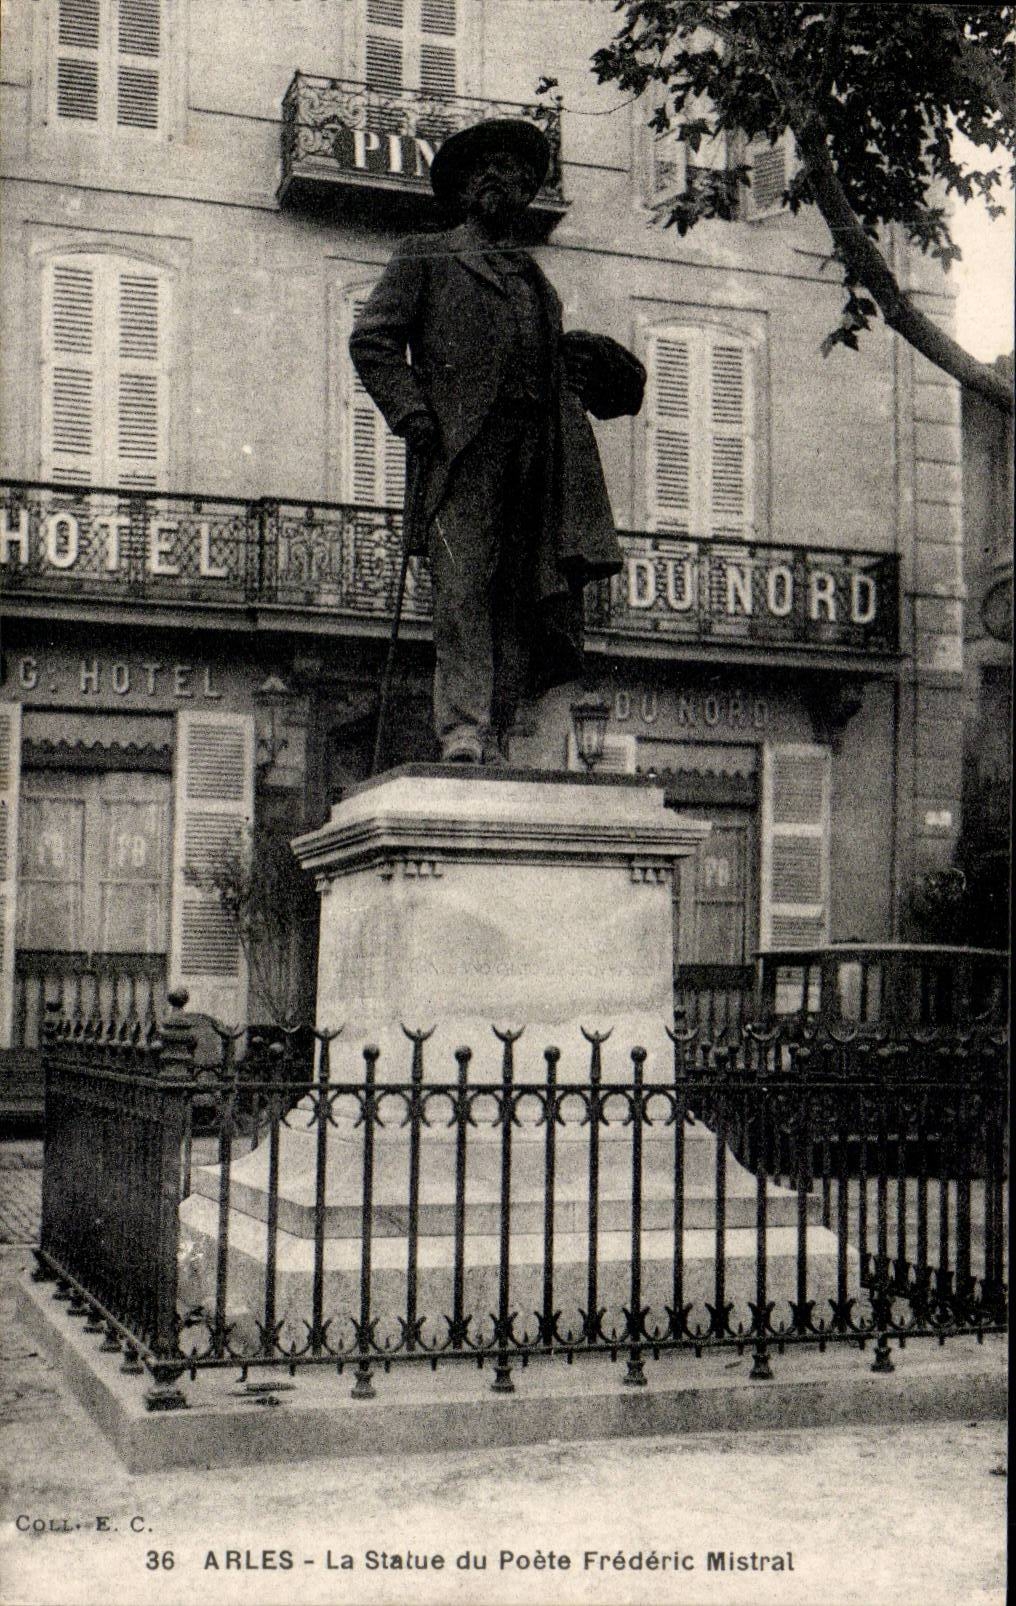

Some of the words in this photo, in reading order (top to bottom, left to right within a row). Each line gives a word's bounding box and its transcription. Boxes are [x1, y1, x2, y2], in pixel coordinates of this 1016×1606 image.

[0, 508, 229, 577] HOTEL
[627, 557, 693, 611] DU
[725, 564, 877, 625] NORD
[79, 659, 223, 698] HOTEL
[614, 691, 658, 723] DU
[677, 695, 769, 728] NORD
